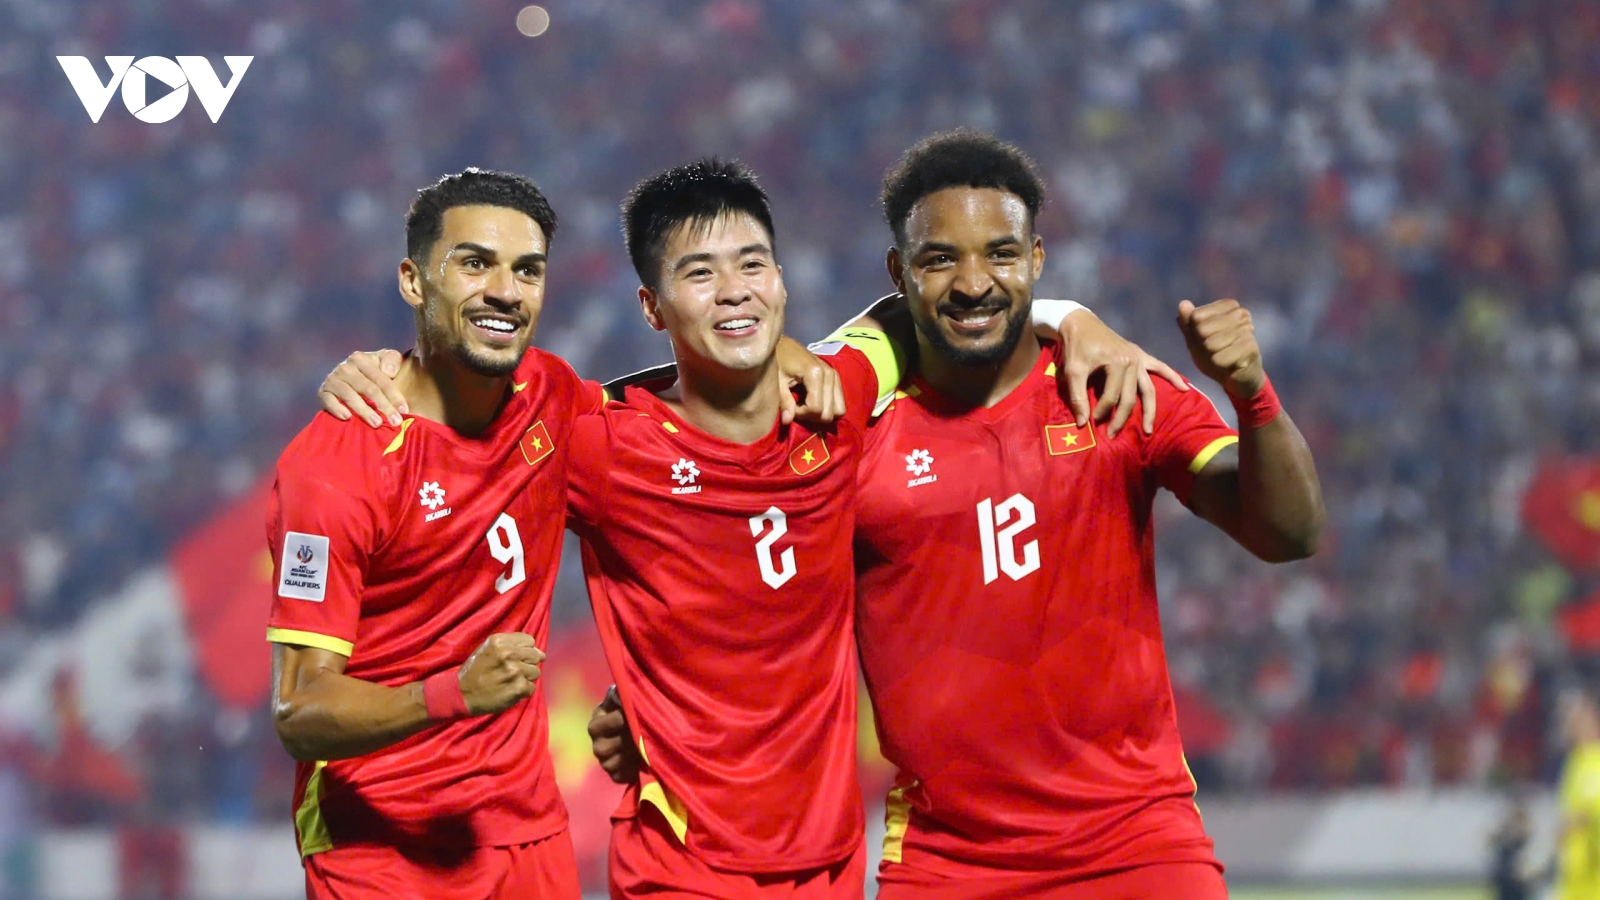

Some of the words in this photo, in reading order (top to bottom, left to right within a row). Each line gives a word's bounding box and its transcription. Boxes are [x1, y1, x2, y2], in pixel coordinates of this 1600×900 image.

[487, 513, 525, 594] 9
[749, 506, 796, 589] 2
[977, 493, 1040, 584] 12
[284, 579, 320, 589] QUALIFIERS
